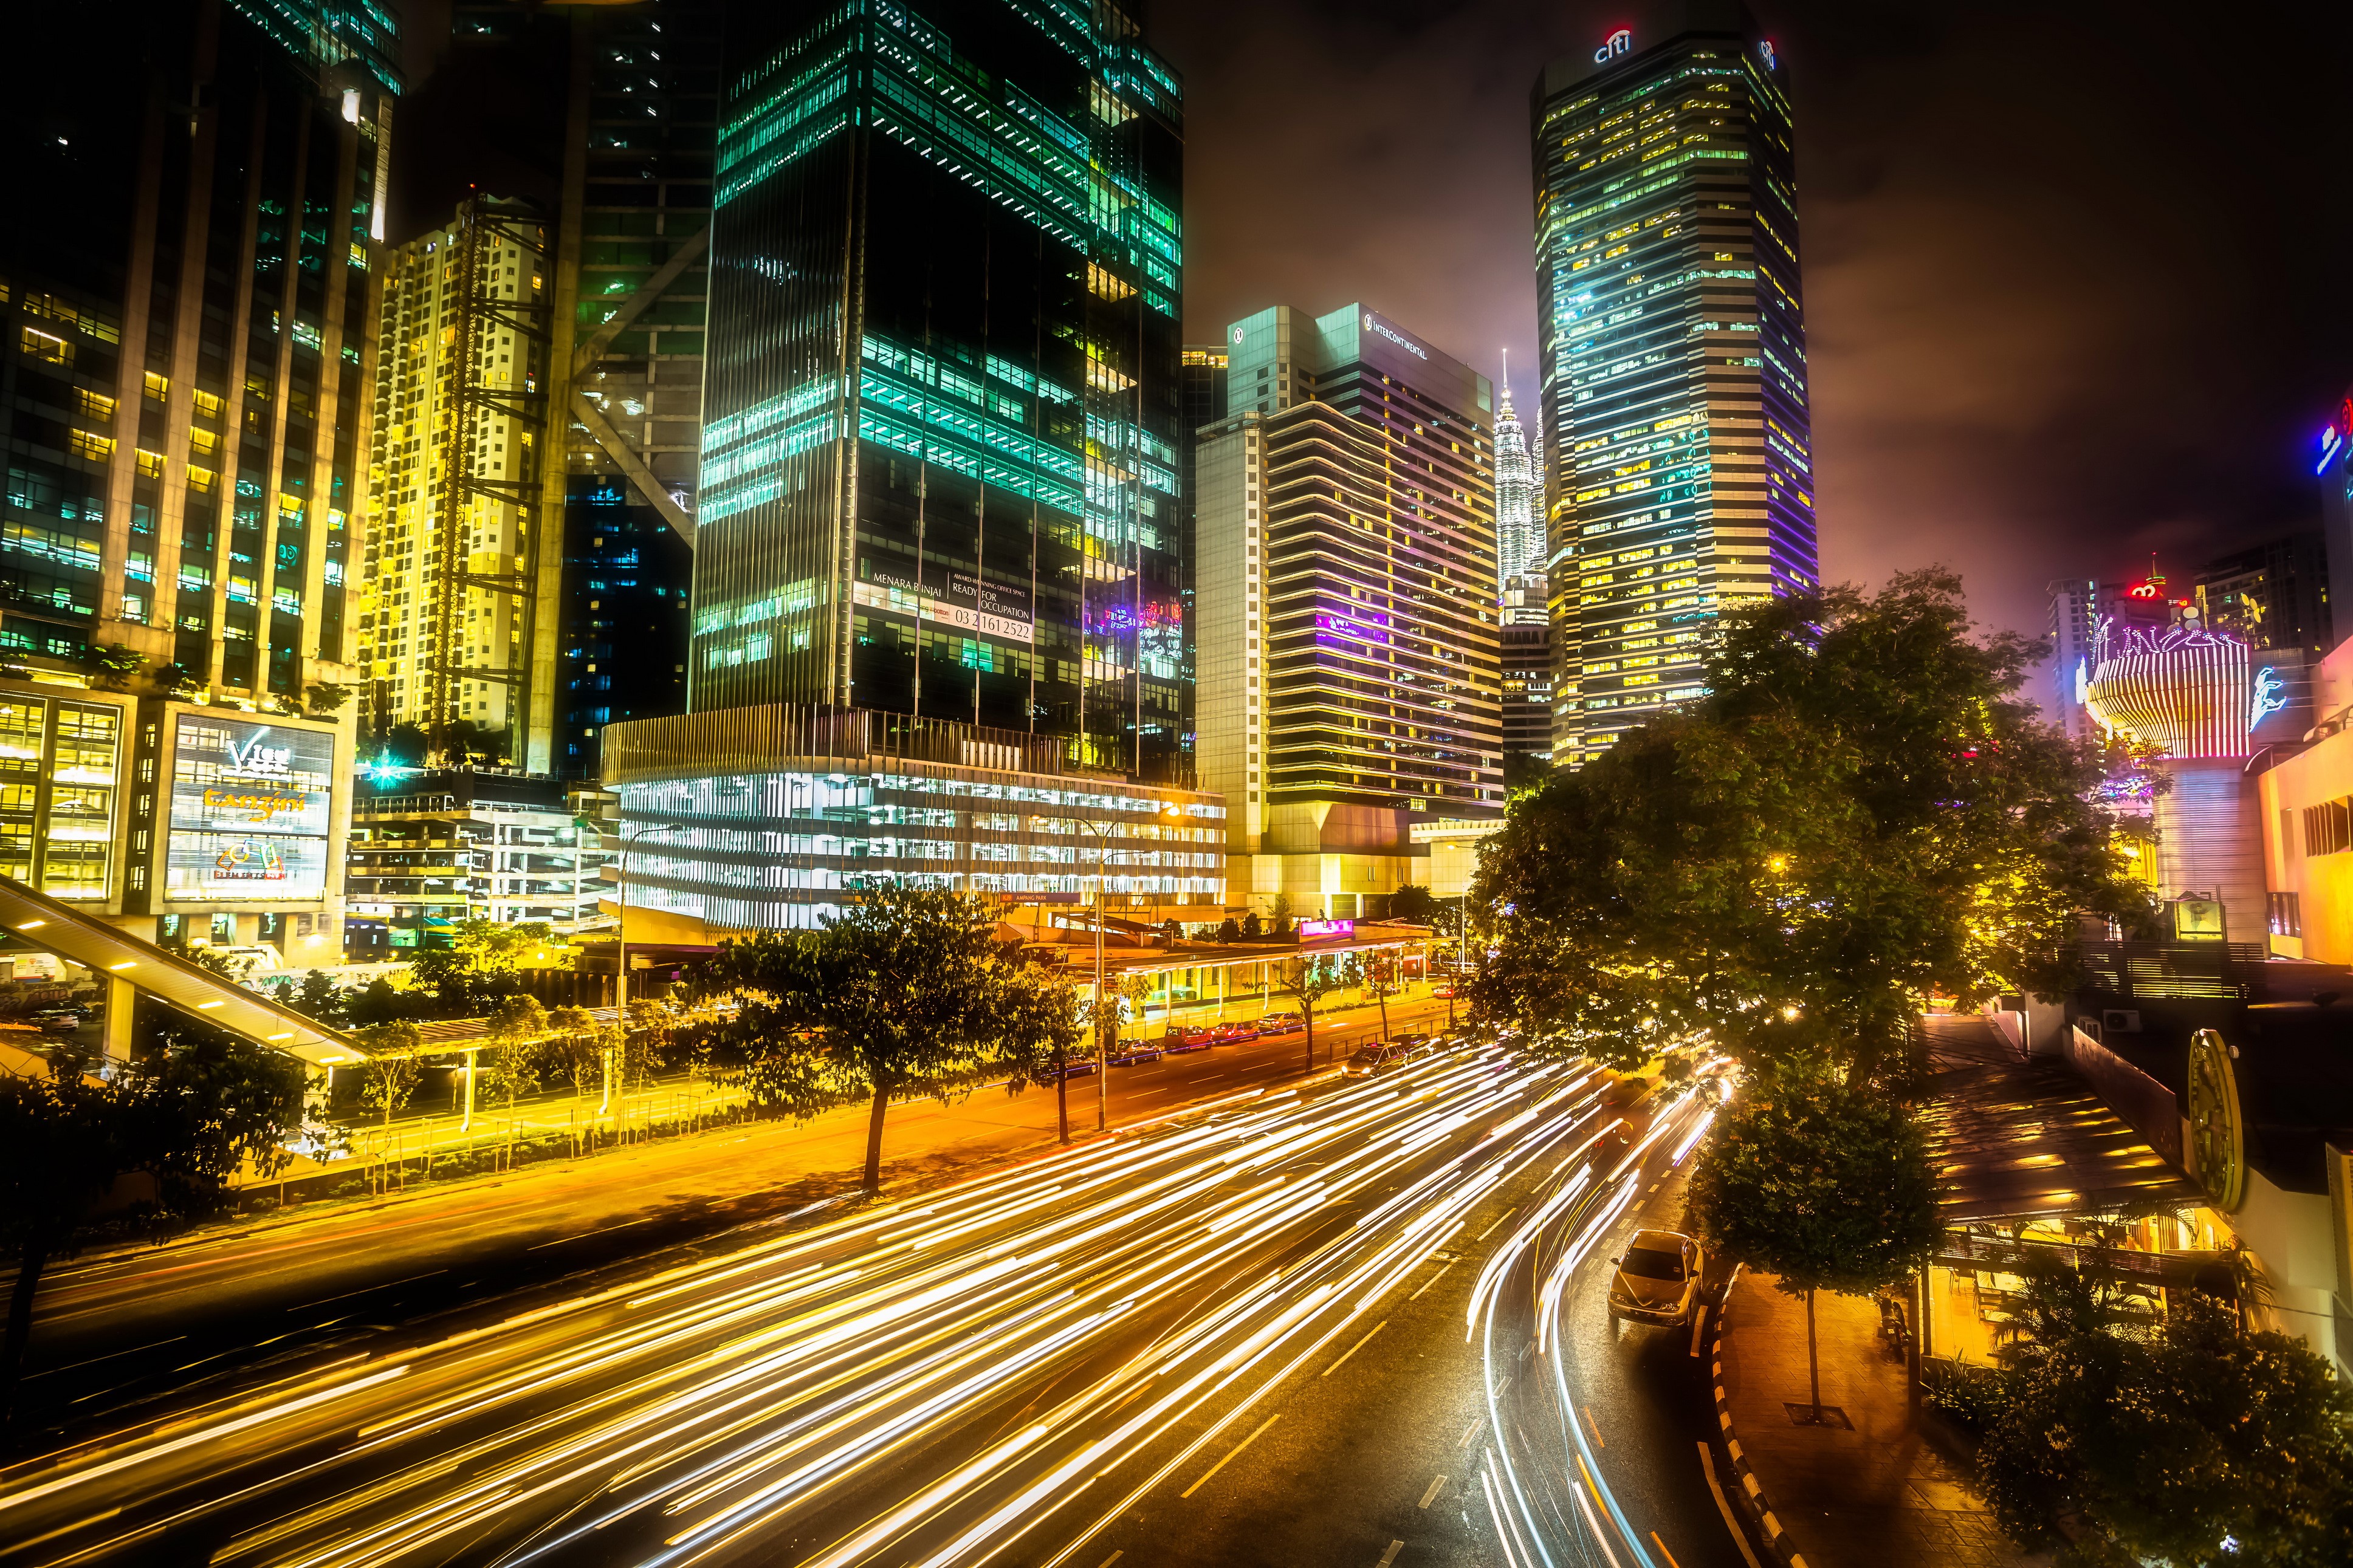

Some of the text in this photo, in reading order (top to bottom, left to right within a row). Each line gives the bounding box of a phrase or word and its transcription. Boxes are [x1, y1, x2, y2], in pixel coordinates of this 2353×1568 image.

[1595, 29, 1630, 63] citi
[873, 572, 911, 590] MENARA
[953, 573, 1025, 597] AWARD-WINNING OFFICE SPACE
[953, 583, 997, 602] READY FOR
[981, 600, 1029, 619] OCCUPATION
[955, 609, 969, 625] 03
[1003, 621, 1029, 638] 2522
[202, 789, 306, 822] tanzini
